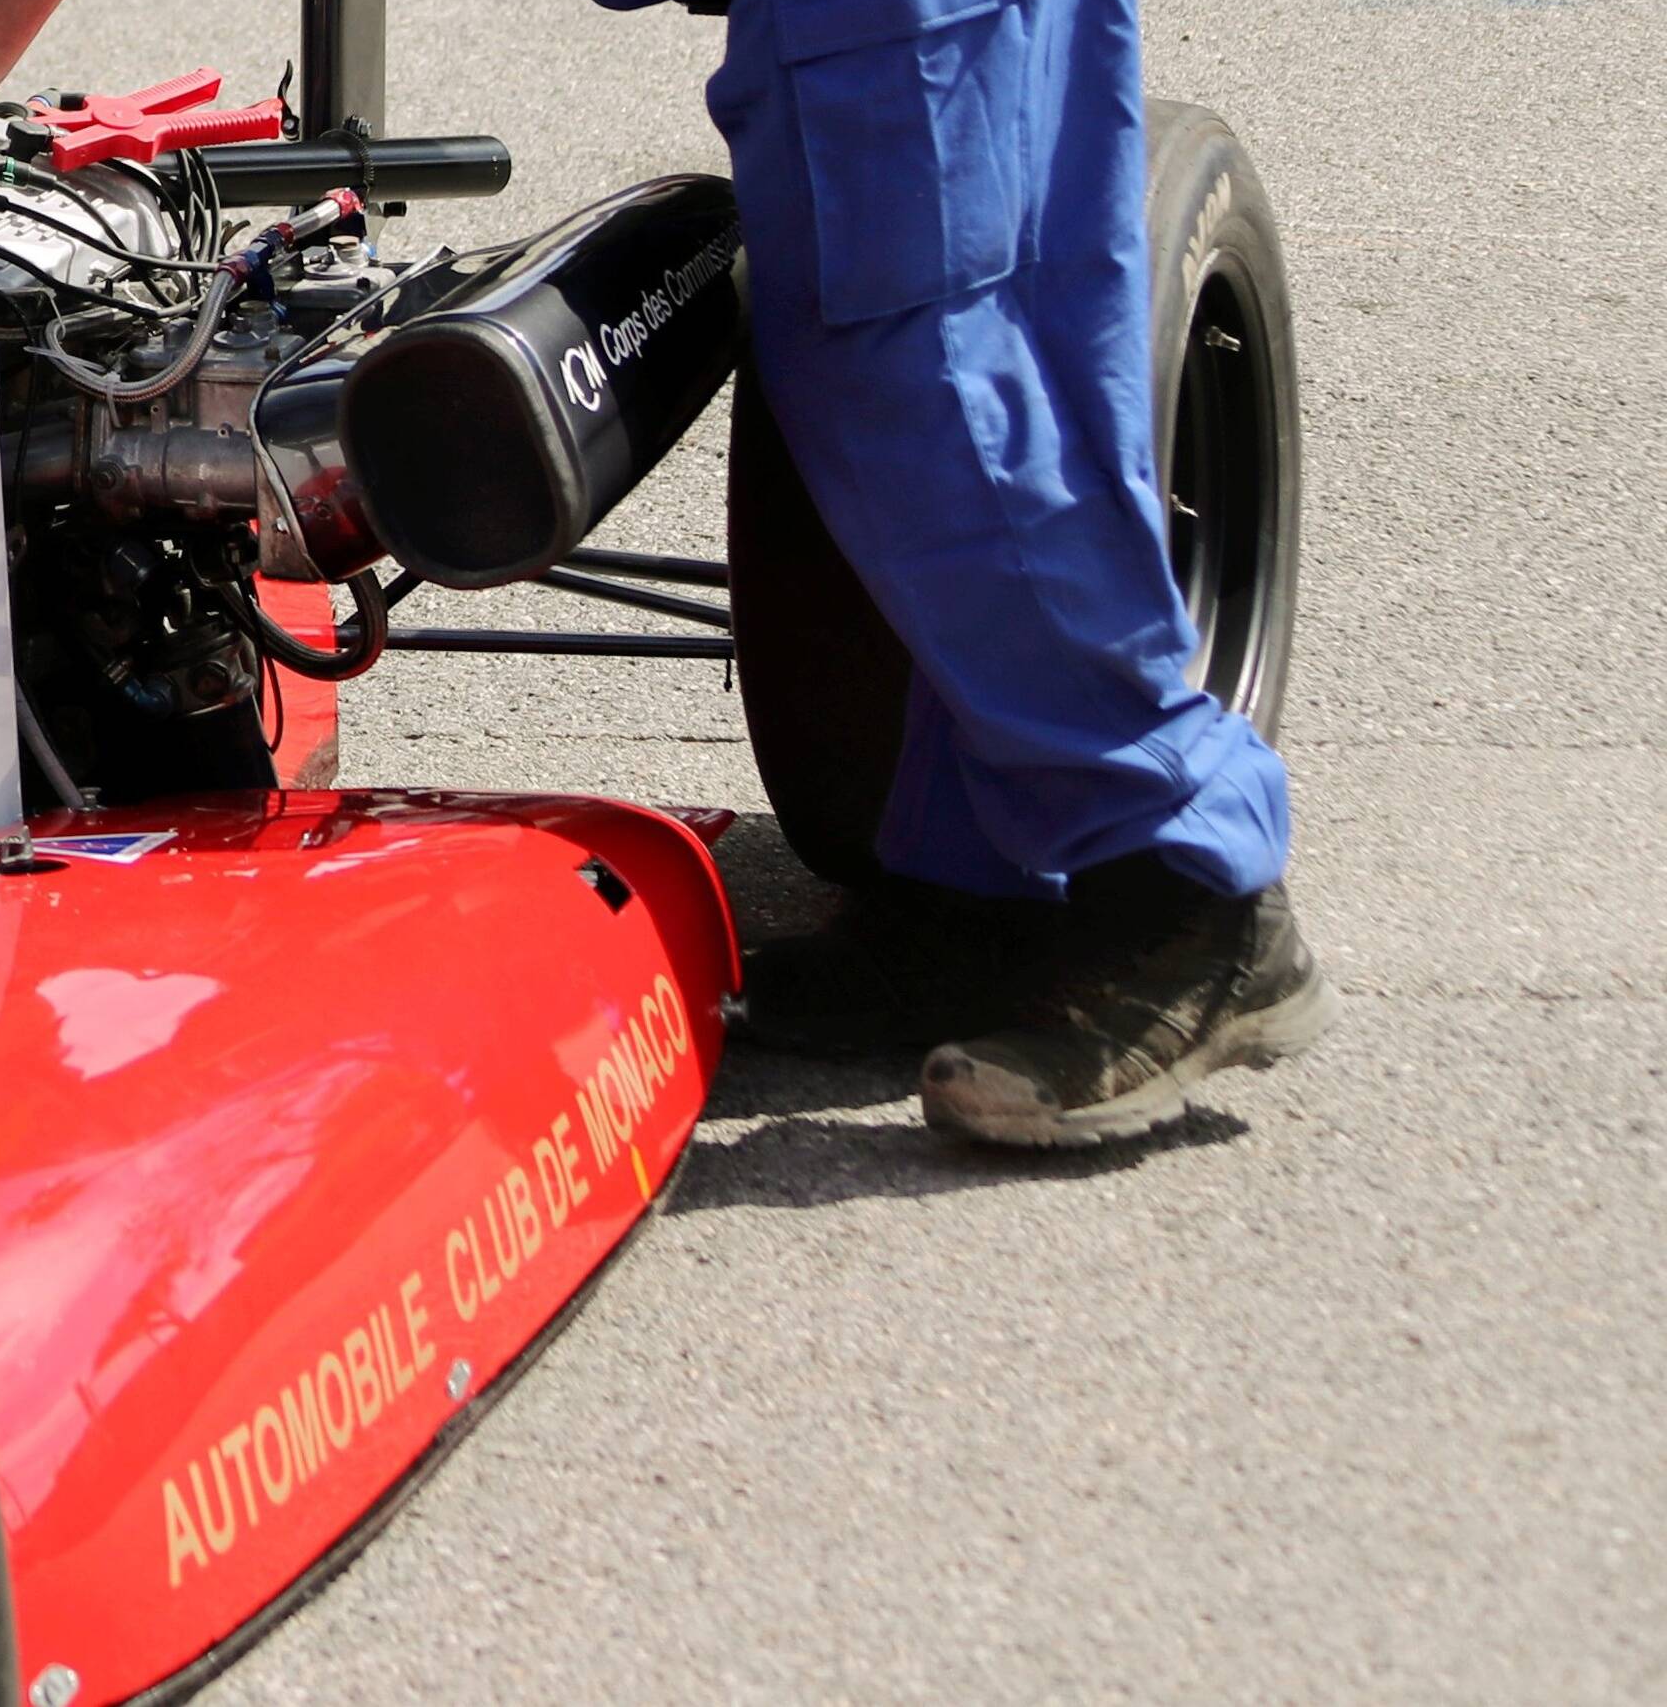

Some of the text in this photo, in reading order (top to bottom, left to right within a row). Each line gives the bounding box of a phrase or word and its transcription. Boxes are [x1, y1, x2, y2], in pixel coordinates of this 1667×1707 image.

[600, 323, 648, 366] Corps
[640, 290, 672, 331] des
[162, 973, 688, 1588] AUTOMOBILE CLUB DE MONACO
